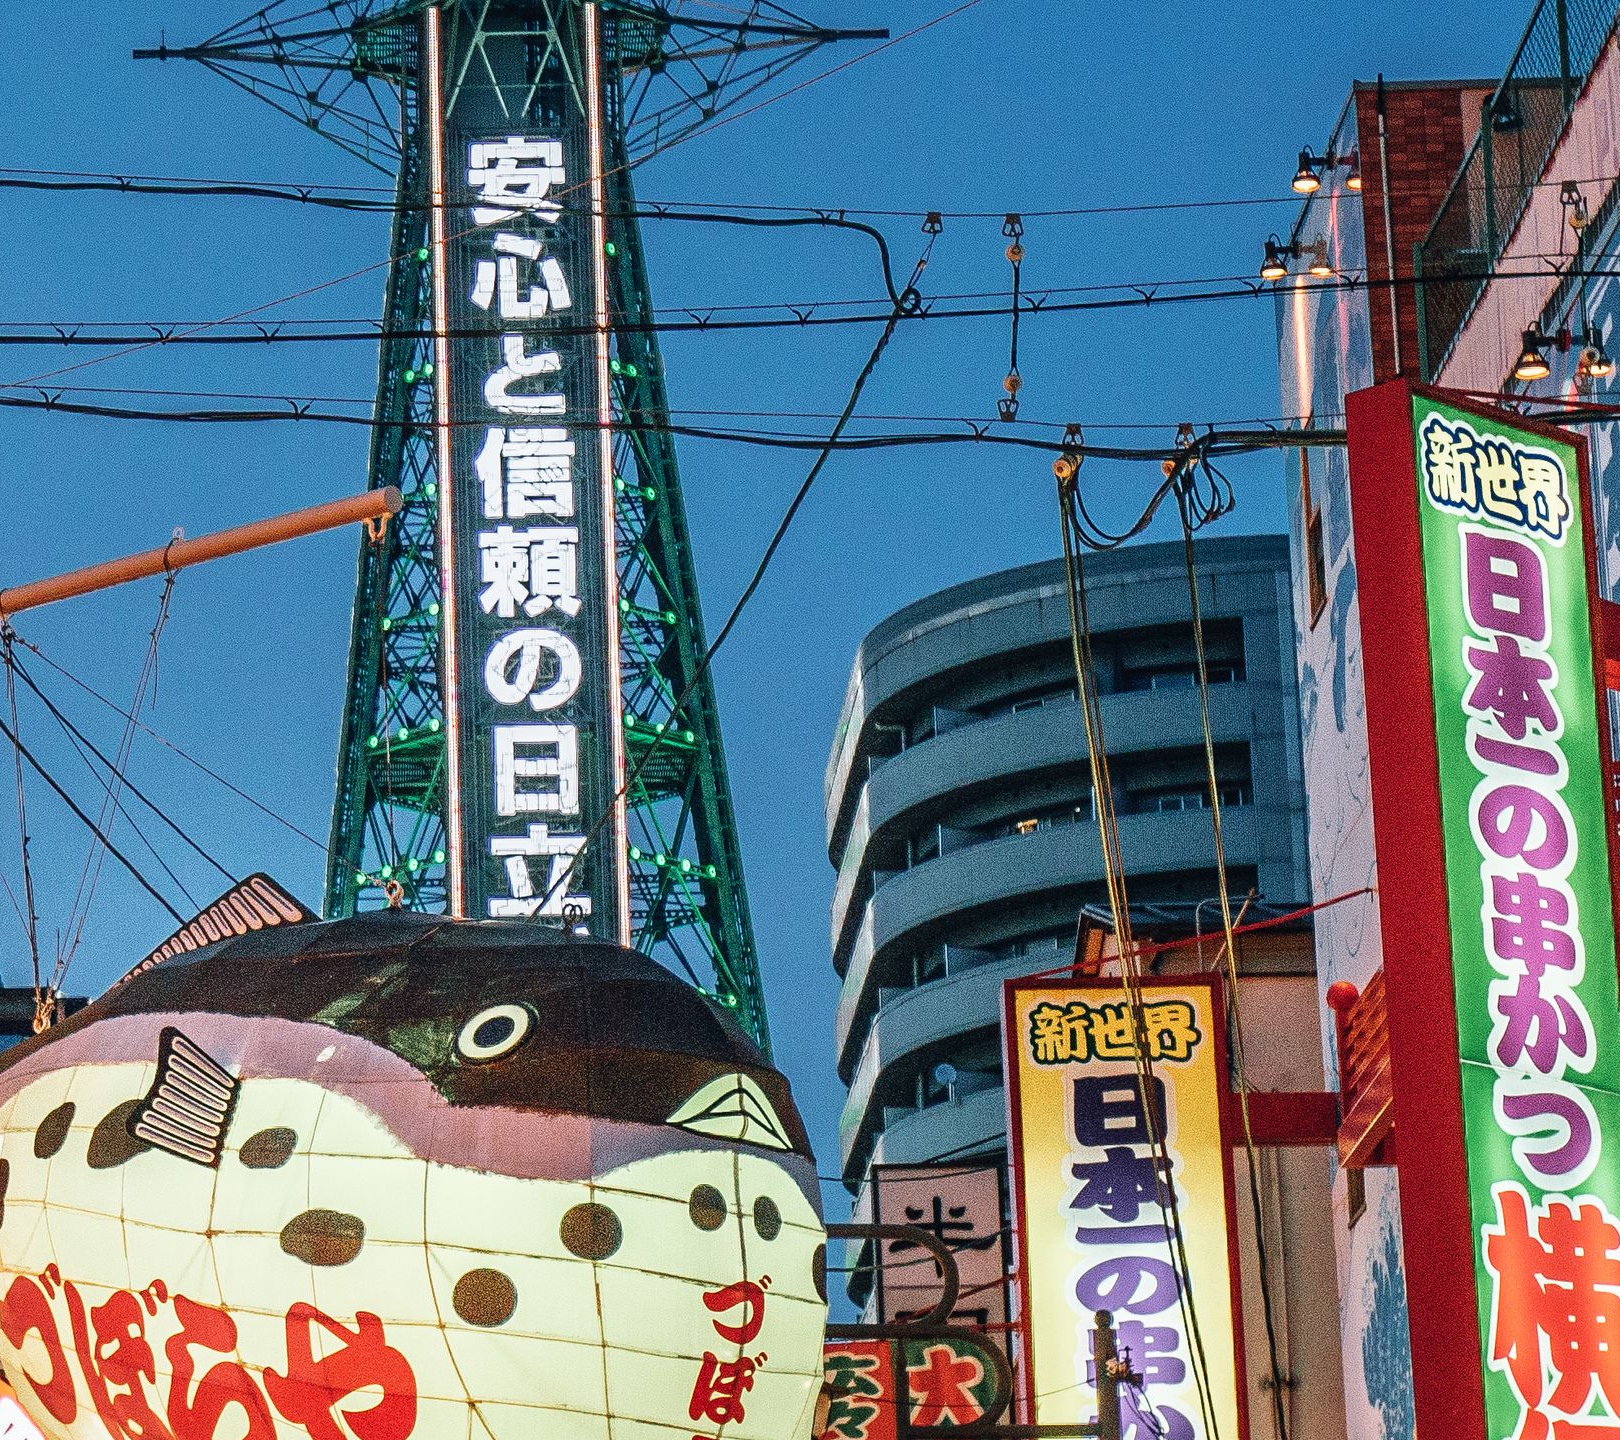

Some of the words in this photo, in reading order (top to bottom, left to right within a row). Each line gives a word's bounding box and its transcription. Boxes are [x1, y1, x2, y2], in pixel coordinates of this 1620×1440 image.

[468, 136, 584, 919] 安心と信頼の日立
[1423, 415, 1569, 540] 新世界
[1030, 1001, 1201, 1064] 新世界
[1462, 536, 1596, 1184] 日本一の串かつ
